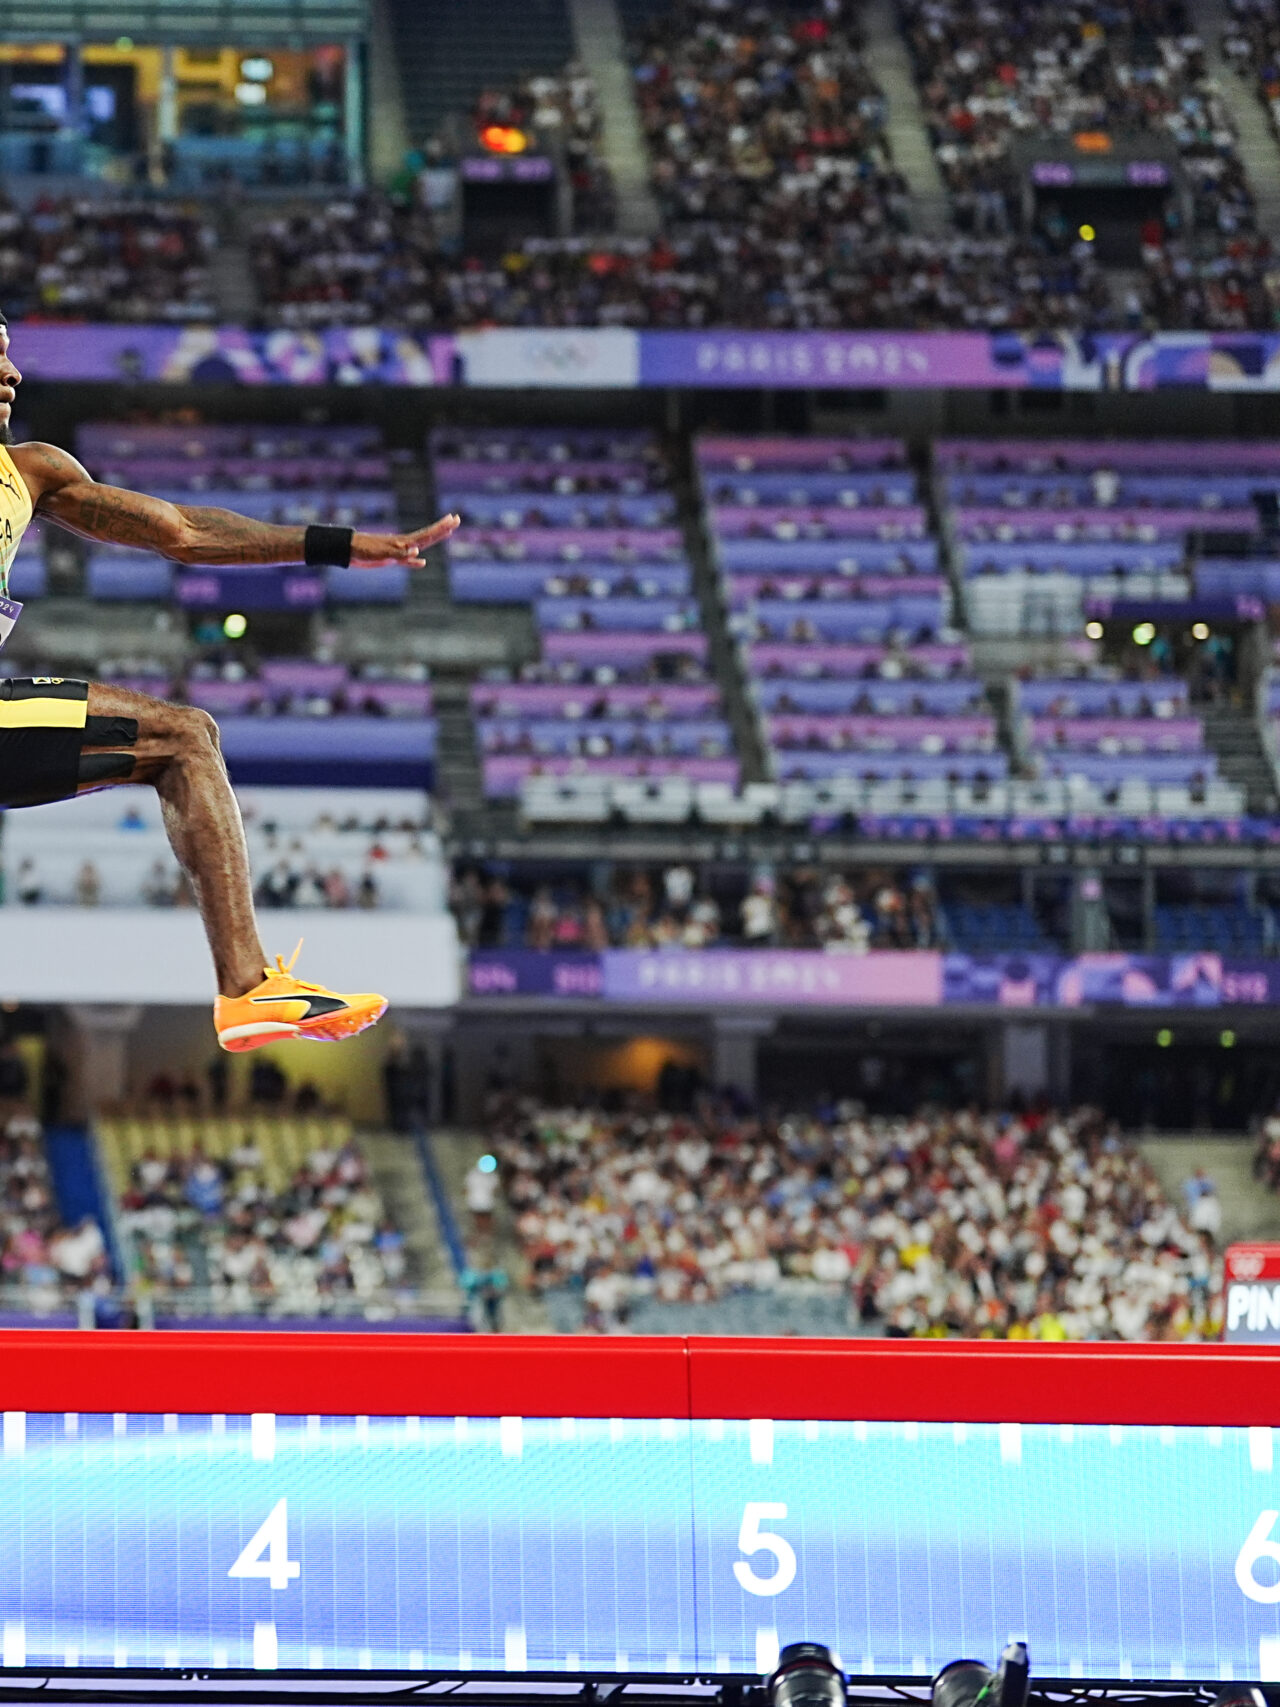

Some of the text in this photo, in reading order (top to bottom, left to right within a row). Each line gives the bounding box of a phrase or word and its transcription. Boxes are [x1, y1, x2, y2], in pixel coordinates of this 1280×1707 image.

[1227, 1284, 1280, 1331] PIN
[228, 1498, 301, 1590] 4
[732, 1502, 798, 1596] 5
[1234, 1509, 1280, 1604] 6
